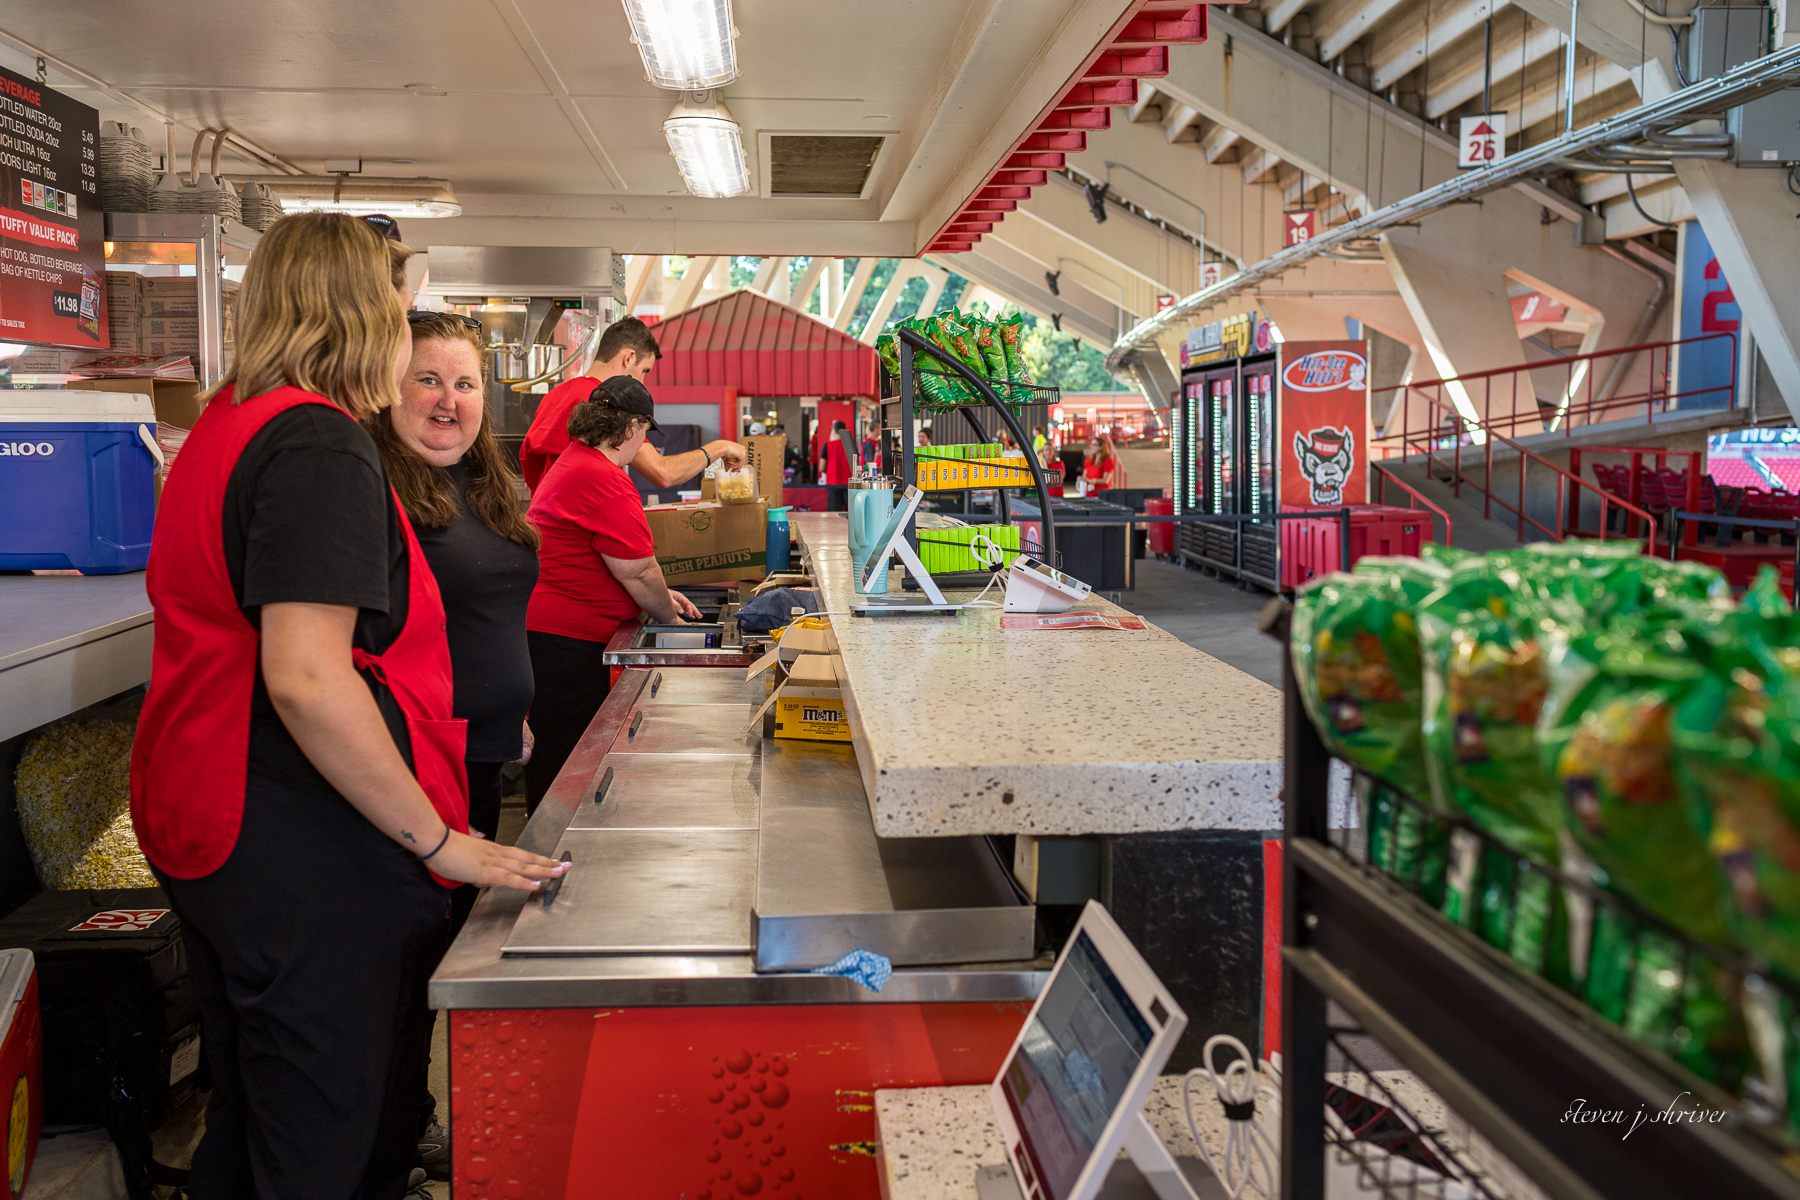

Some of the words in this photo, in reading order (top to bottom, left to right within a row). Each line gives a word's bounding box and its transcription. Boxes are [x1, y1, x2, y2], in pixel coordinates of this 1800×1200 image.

[25, 106, 48, 126] WATER
[48, 116, 62, 132] 20oz
[26, 124, 45, 142] SODA
[46, 132, 60, 148] 20oz
[82, 130, 94, 144] 5.49
[14, 137, 36, 156] ULTRA
[36, 146, 50, 162] 16oz
[82, 146, 94, 160] 5.99
[1469, 140, 1496, 162] 26
[0, 151, 21, 170] OORS
[22, 158, 42, 176] LIGHT
[43, 166, 56, 182] 16oz
[80, 162, 95, 178] 13.29
[82, 180, 96, 194] 11.49
[0, 214, 27, 234] TUFFY
[29, 222, 55, 241] VALUE
[56, 230, 76, 246] PACK
[1290, 226, 1309, 244] 19
[1, 246, 14, 260] HOT
[14, 250, 29, 264] DOG,
[30, 252, 54, 268] BOTTLED
[56, 258, 83, 274] BEVERAGE
[1, 262, 14, 276] BAG
[14, 265, 23, 276] OF
[24, 267, 46, 282] KETTLE
[46, 272, 62, 284] CHIPS
[54, 296, 78, 312] $11.98
[0, 442, 54, 456] GLOO
[695, 549, 751, 570] PEANUTS
